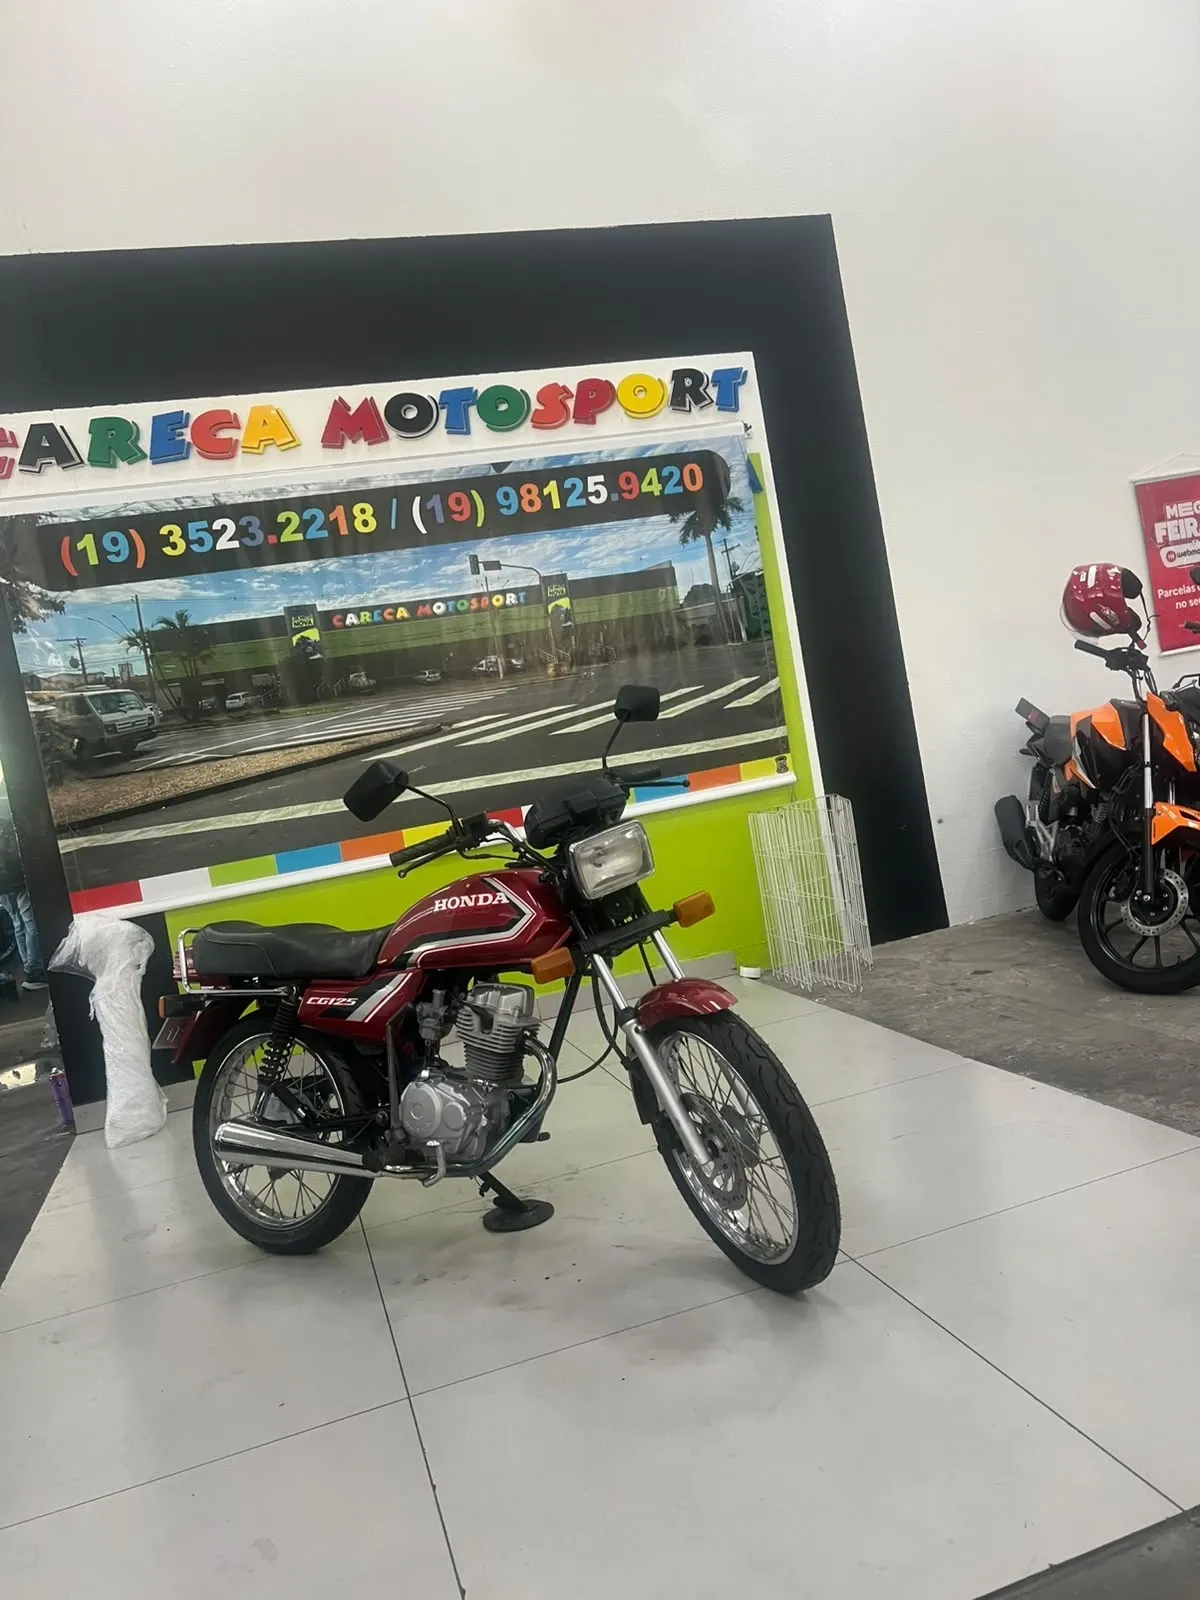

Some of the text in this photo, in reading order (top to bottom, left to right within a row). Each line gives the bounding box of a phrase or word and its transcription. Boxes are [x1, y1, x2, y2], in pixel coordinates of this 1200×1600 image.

[321, 367, 748, 449] MOTOSPORT
[60, 528, 146, 576] (19)
[159, 502, 377, 556] 3523.2218
[412, 489, 485, 534] (19)
[496, 463, 704, 516] 98125.9420
[1154, 517, 1200, 544] FEIR
[1157, 584, 1196, 599] Parcelas
[332, 592, 526, 629] CARECA MOTOSPORT
[1175, 598, 1200, 609] no se
[433, 892, 510, 912] HONDA
[306, 996, 359, 1006] CG125
